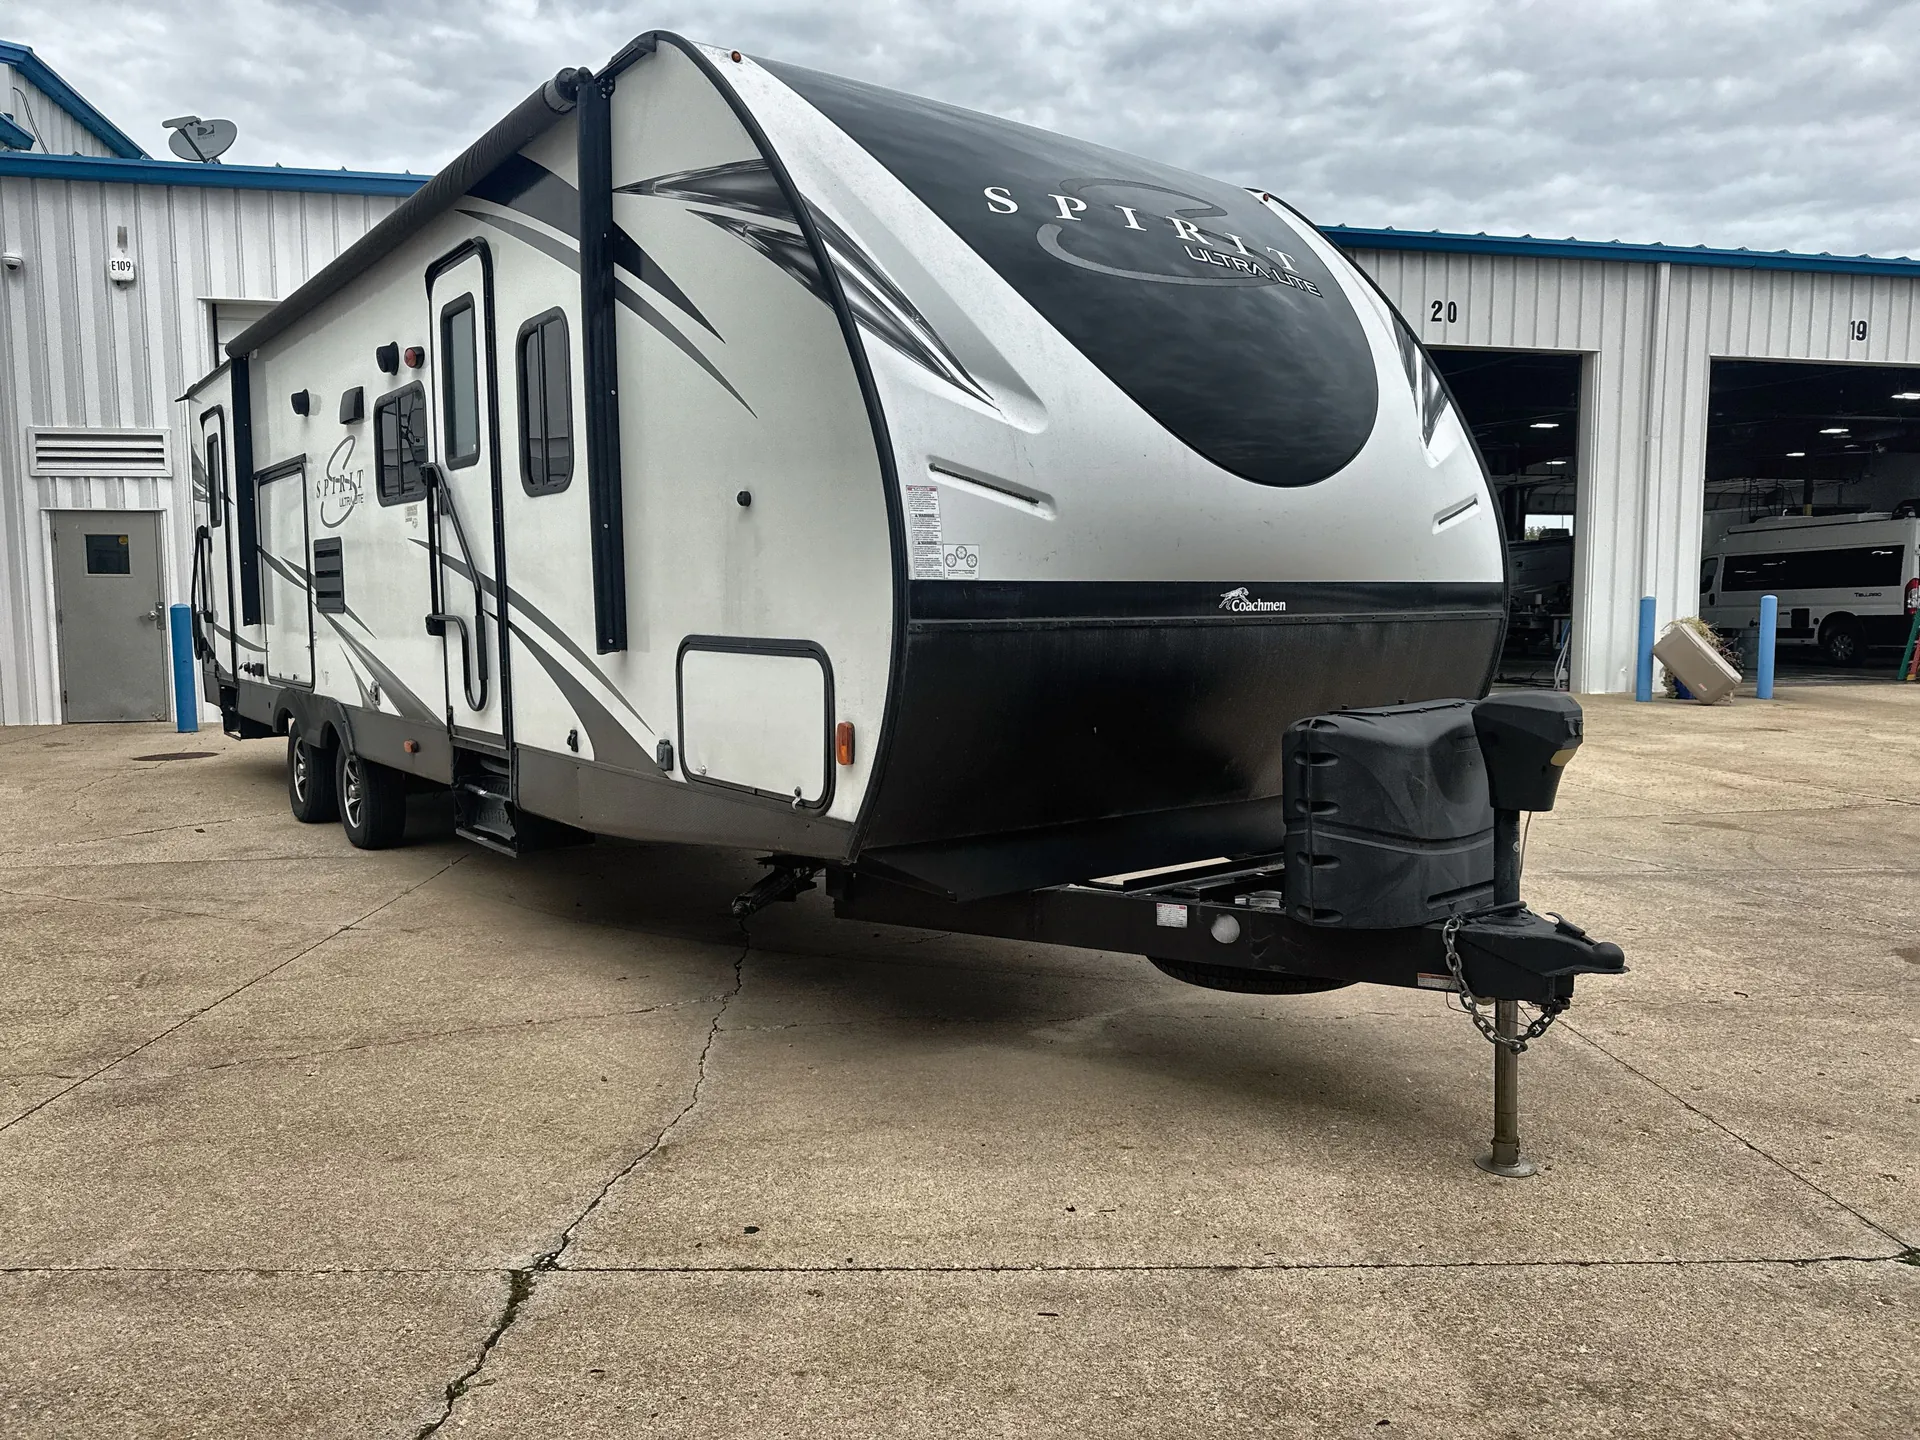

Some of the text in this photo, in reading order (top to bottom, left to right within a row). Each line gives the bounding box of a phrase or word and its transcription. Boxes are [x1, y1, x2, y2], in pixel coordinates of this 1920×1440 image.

[983, 186, 1300, 274] SPIRIT
[111, 260, 131, 271] E109
[1431, 300, 1457, 323] 20
[1850, 320, 1868, 341] 19
[316, 469, 364, 499] SPIRIT
[1231, 598, 1286, 612] Coachmen
